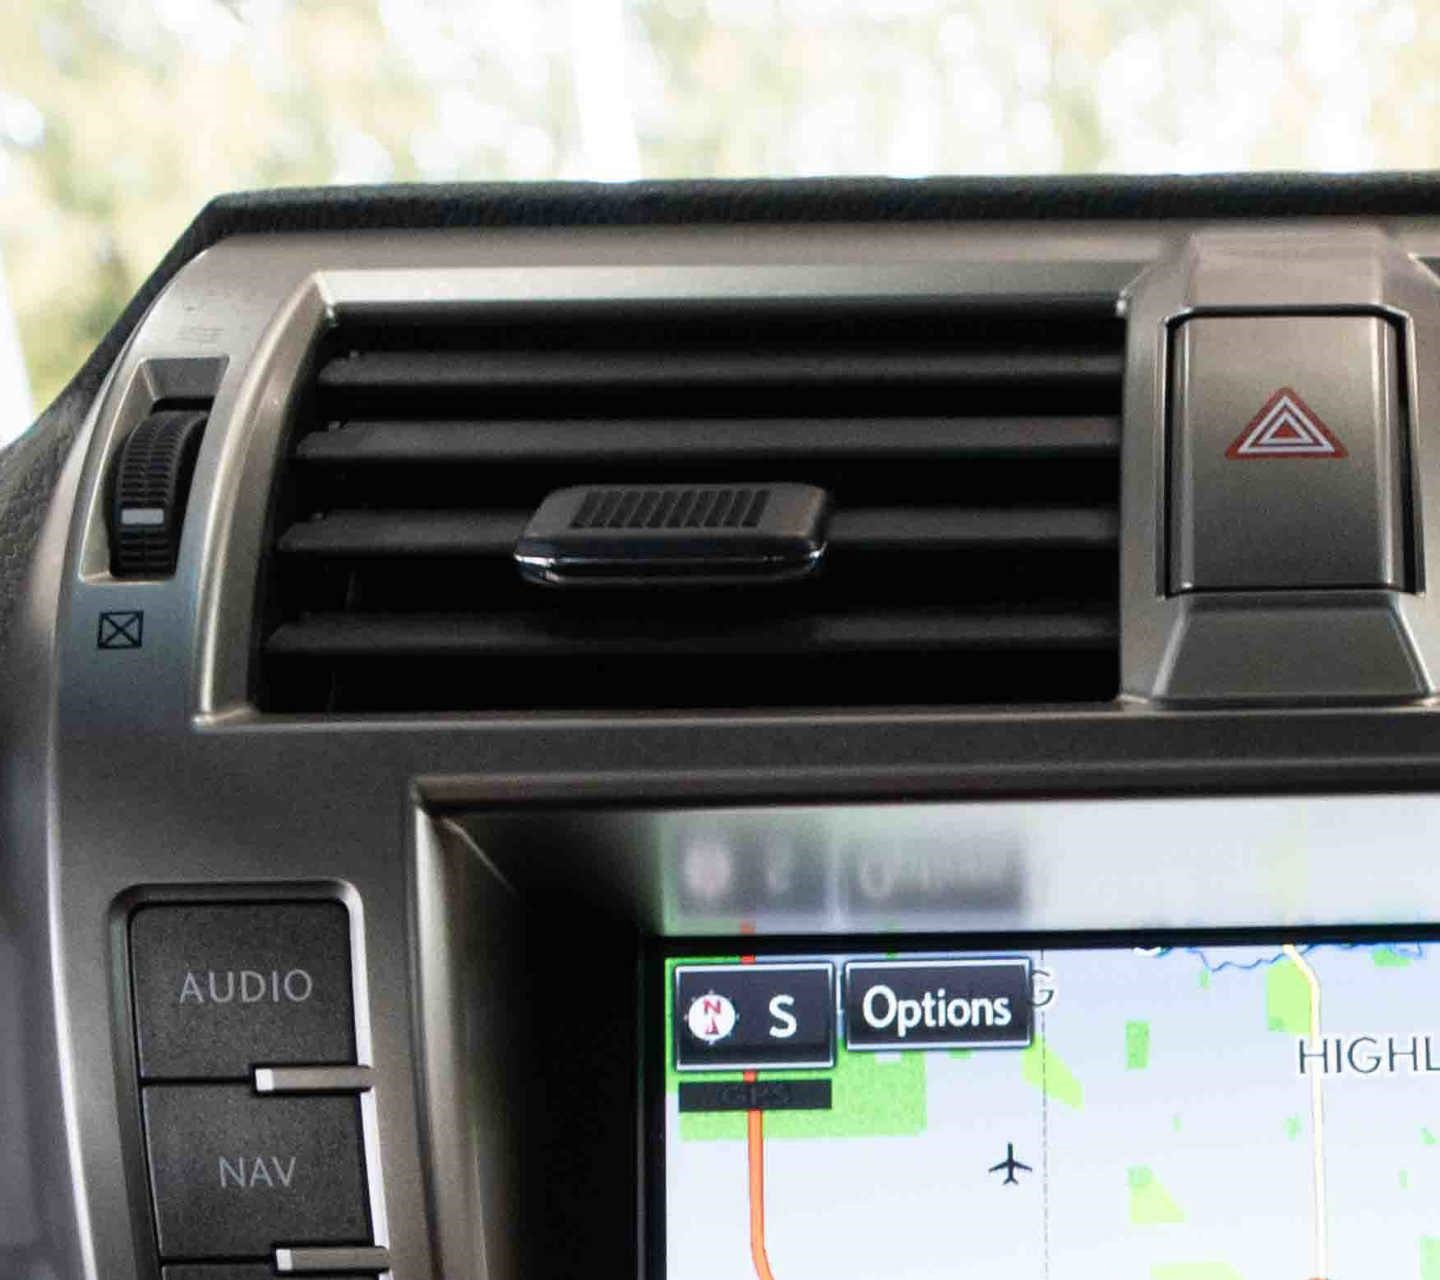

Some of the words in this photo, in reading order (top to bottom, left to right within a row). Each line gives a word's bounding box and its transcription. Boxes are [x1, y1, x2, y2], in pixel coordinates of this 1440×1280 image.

[179, 969, 313, 1003] AUDIO
[769, 994, 797, 1038] S
[863, 985, 1012, 1037] Options
[219, 1156, 296, 1188] NAV
